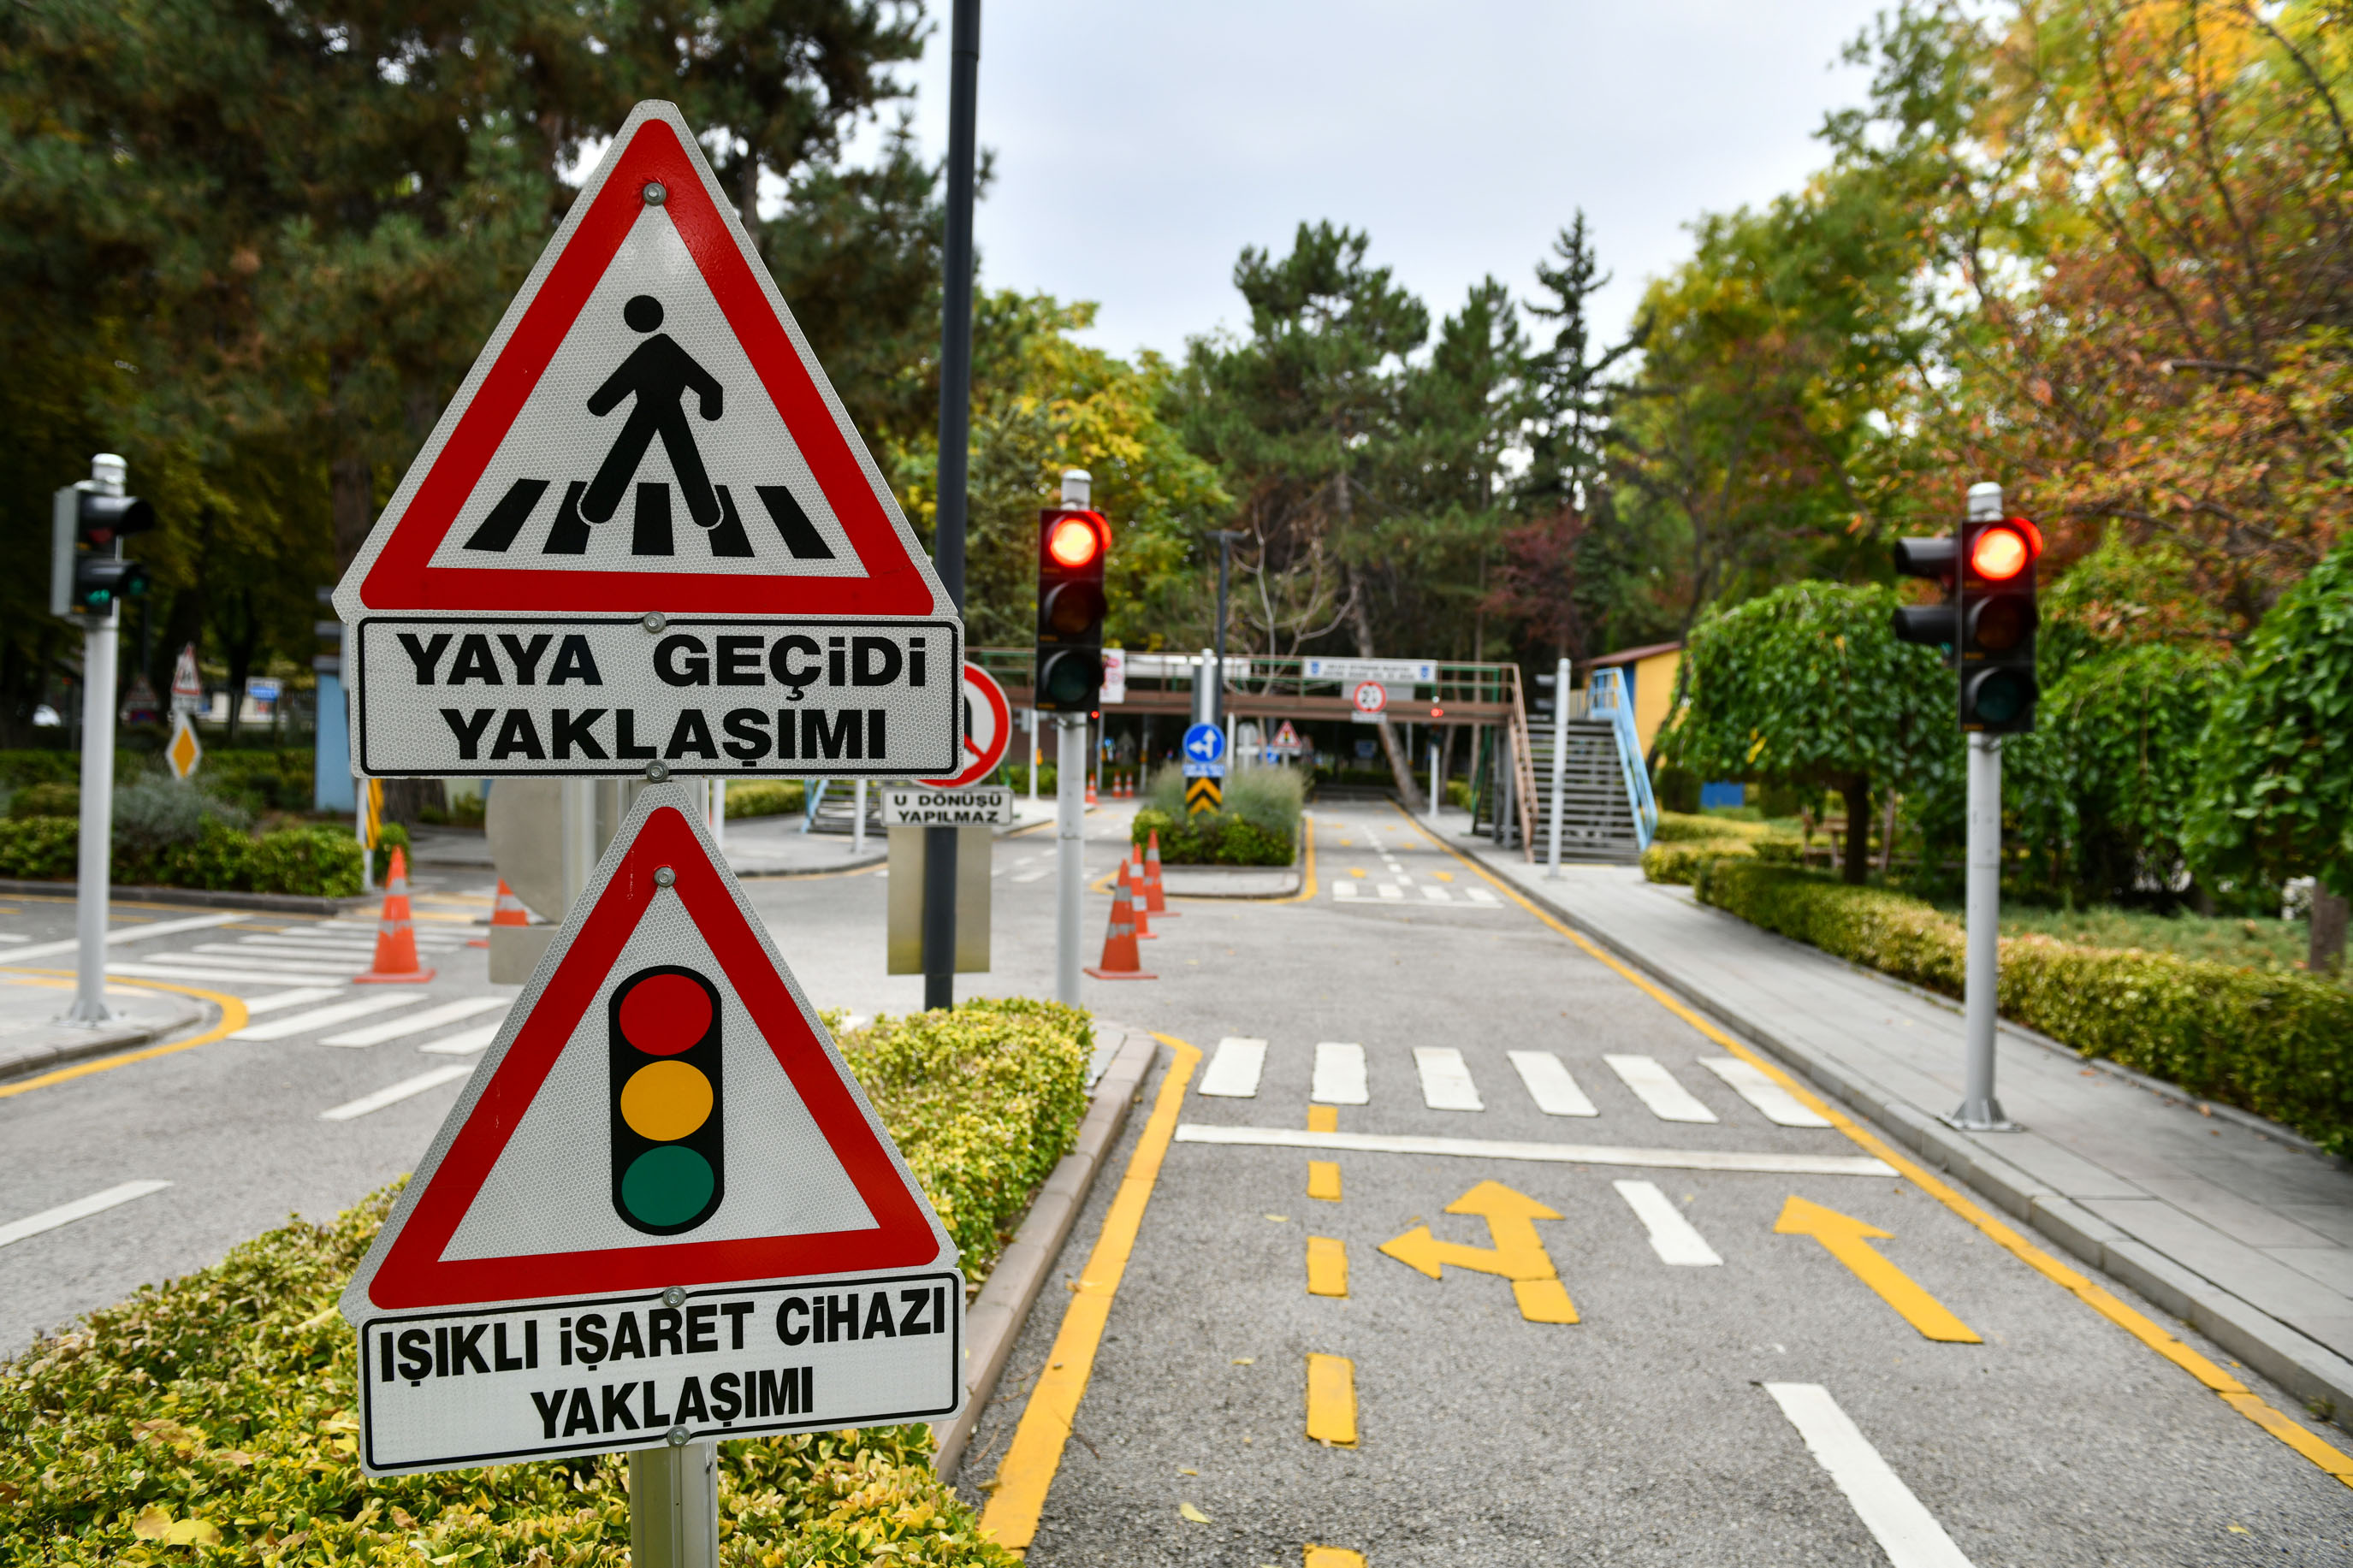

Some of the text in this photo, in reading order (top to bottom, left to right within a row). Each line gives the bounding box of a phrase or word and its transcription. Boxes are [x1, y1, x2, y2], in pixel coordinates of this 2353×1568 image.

[396, 633, 603, 686] YAYA
[439, 707, 886, 767] YAKLAŞIMI
[894, 791, 1002, 808] U DÖNÜŞÜ
[898, 811, 999, 823] YAPILMAZ
[381, 1319, 538, 1388] IŞIKLI
[530, 1366, 814, 1440] YAKLAŞIMI
